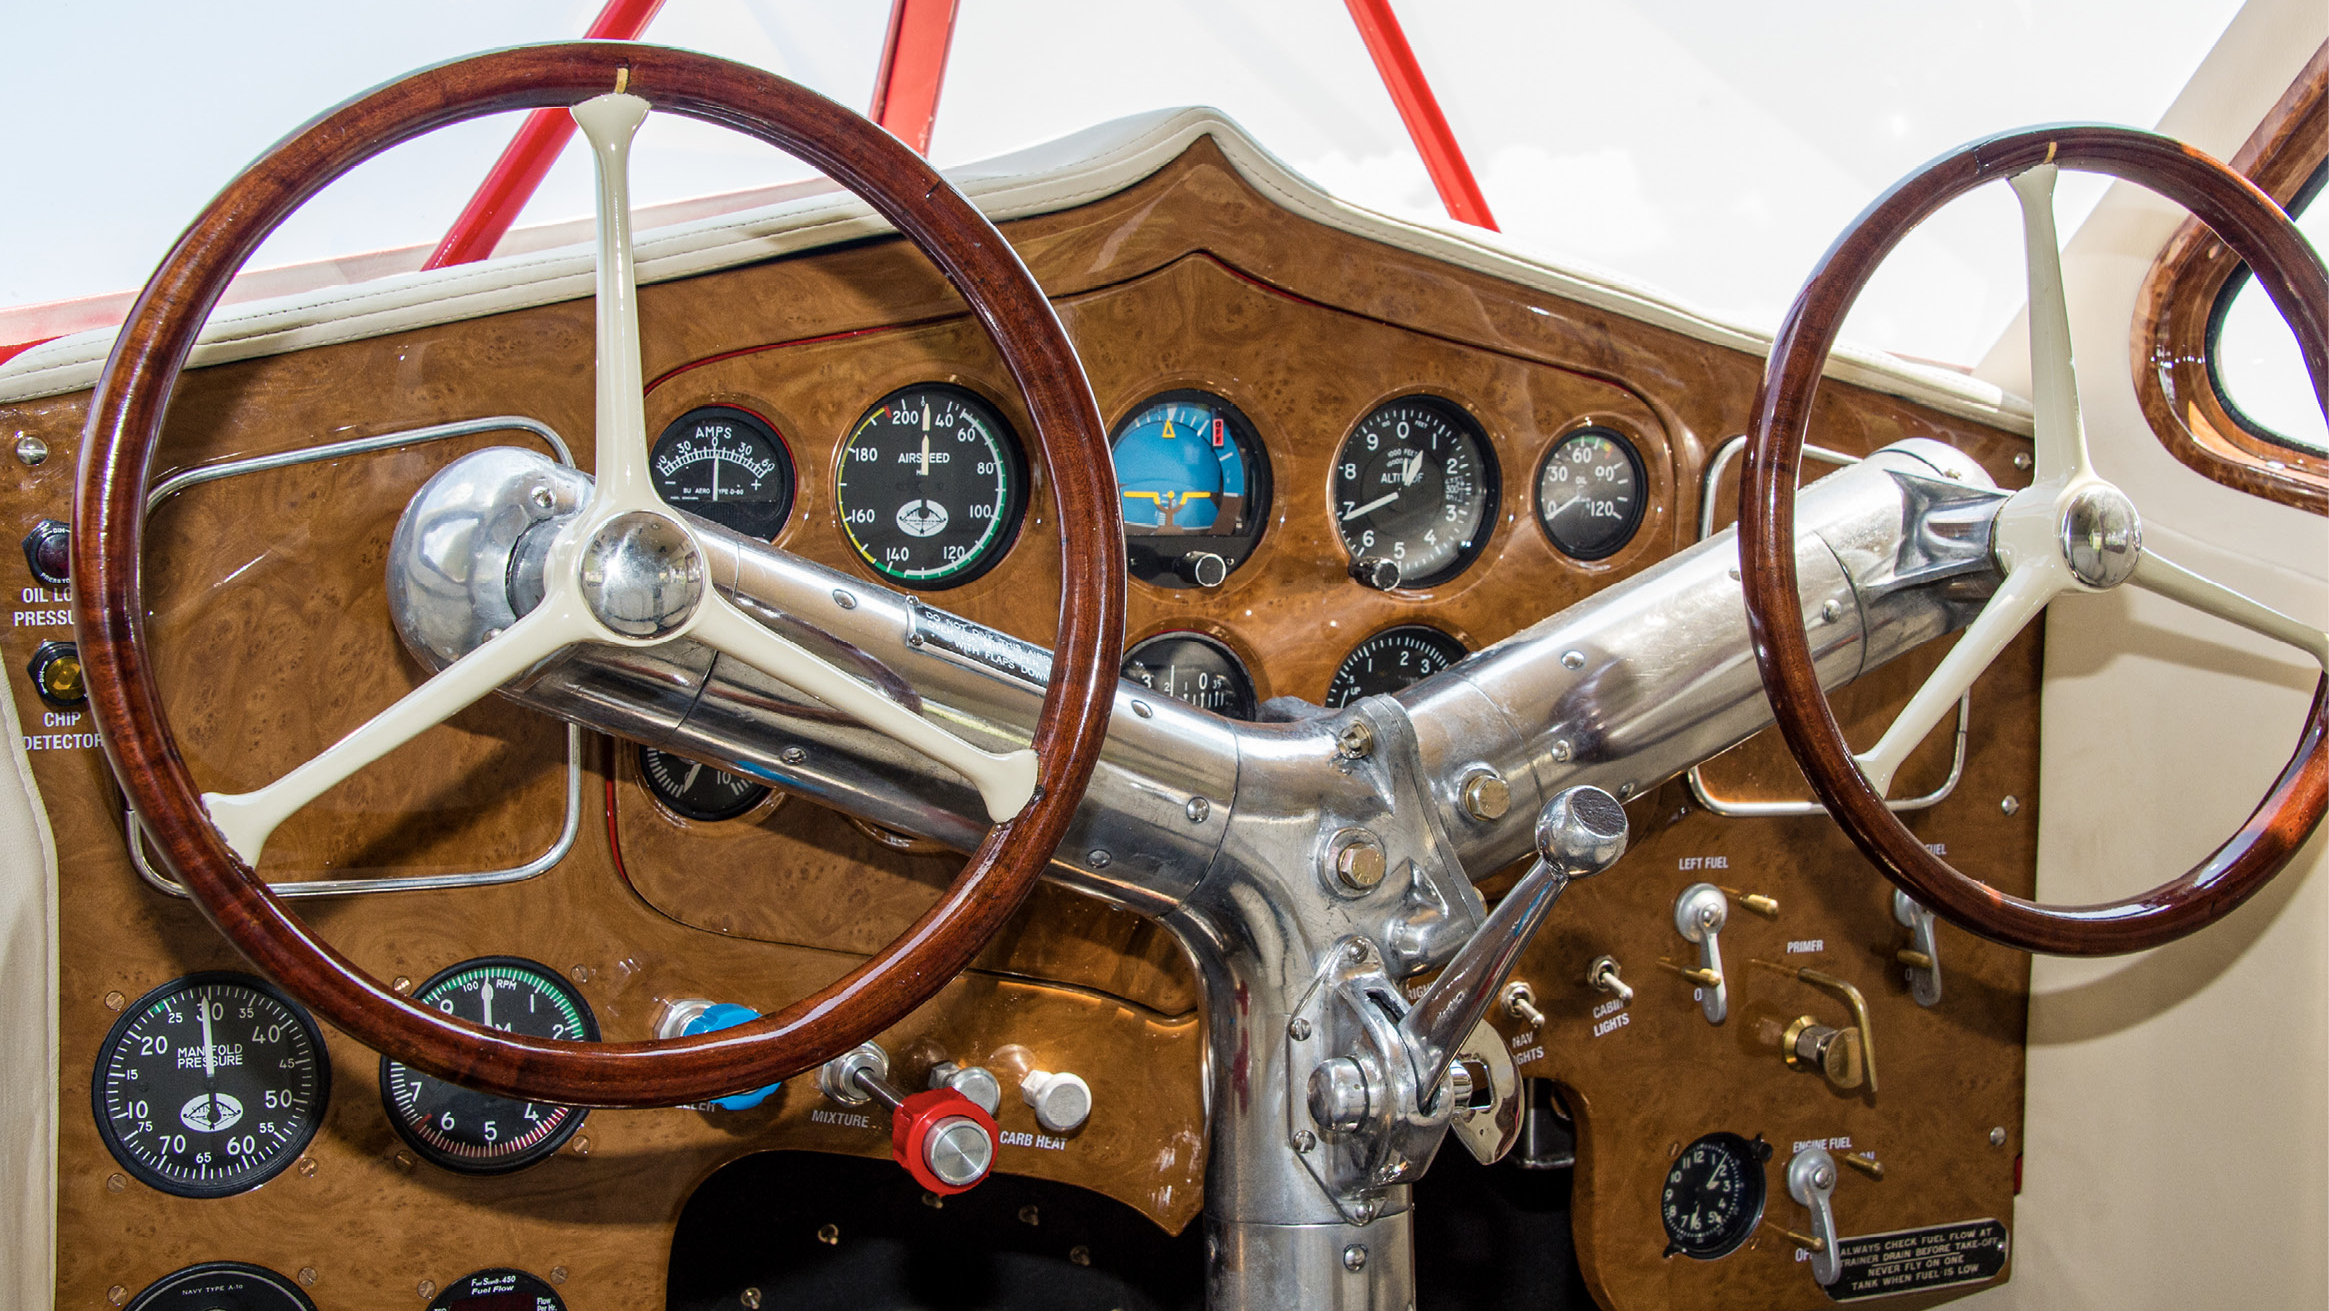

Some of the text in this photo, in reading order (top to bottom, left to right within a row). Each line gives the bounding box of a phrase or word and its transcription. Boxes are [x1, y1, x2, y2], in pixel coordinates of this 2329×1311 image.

[892, 410, 919, 425] 200
[935, 413, 953, 428] 40
[695, 426, 733, 439] AMPS
[957, 427, 976, 442] 60
[1396, 421, 1410, 439] 0
[677, 440, 692, 454] 30
[711, 437, 719, 446] 0
[738, 442, 752, 455] 30
[1366, 433, 1379, 451] 9
[855, 447, 877, 462] 180
[898, 452, 950, 464] AIRSEED
[1572, 447, 1592, 463] 60
[761, 458, 775, 472] 60
[977, 461, 995, 475] 80
[1344, 463, 1356, 480] 8
[1446, 458, 1458, 475] 2
[1549, 465, 1568, 482] 30
[969, 504, 992, 519] 100
[1343, 501, 1355, 514] 7
[1445, 504, 1457, 522] 3
[1590, 501, 1614, 517] 120
[852, 508, 875, 523] 160
[1362, 530, 1375, 547] 6
[1424, 528, 1437, 546] 4
[886, 546, 910, 561] 140
[943, 545, 965, 560] 120
[1394, 542, 1405, 559] 5
[22, 587, 73, 603] OIL LO
[13, 609, 75, 627] PRESSU
[926, 611, 941, 621] DO
[946, 618, 967, 631] NOT
[954, 640, 980, 656] WITH
[985, 651, 1016, 670] FLAPS
[1021, 664, 1049, 682] DOWN
[1399, 651, 1409, 666] 2
[1420, 658, 1430, 674] 3
[1199, 672, 1208, 690] 0
[1350, 686, 1361, 696] UP
[43, 711, 81, 728] CHIP
[22, 733, 102, 751] DETECTOR
[717, 770, 732, 786] 10
[1678, 856, 1729, 871] LEFT FUEL
[1786, 939, 1824, 954] PRIMER
[463, 979, 517, 993] 100 RPM
[168, 1013, 183, 1024] 25
[239, 1007, 254, 1019] 35
[552, 1024, 564, 1040] 2
[1593, 1012, 1630, 1037] LIGHTS
[252, 1024, 281, 1044] 40
[1512, 1031, 1533, 1048] NAV
[141, 1036, 168, 1056] 20
[177, 1043, 243, 1058] MANFOLD
[177, 1054, 243, 1069] PRESSURE
[279, 1057, 295, 1069] 45
[1514, 1046, 1545, 1066] GHTS
[126, 1069, 139, 1080] 15
[265, 1089, 293, 1109] 50
[410, 1082, 422, 1102] 7
[128, 1100, 148, 1119] 10
[524, 1102, 539, 1122] 4
[138, 1121, 153, 1132] 75
[441, 1112, 455, 1131] 6
[811, 1109, 870, 1129] MIXTURE
[259, 1122, 275, 1134] 55
[484, 1121, 498, 1141] 5
[159, 1135, 187, 1155] 70
[226, 1135, 256, 1155] 60
[1000, 1130, 1068, 1151] CARB HEAT
[1793, 1136, 1853, 1154] ENGINE FUEL
[195, 1152, 212, 1164] 65
[1682, 1157, 1691, 1169] 11
[1694, 1150, 1705, 1164] 12
[1670, 1170, 1682, 1184] 10
[1720, 1164, 1727, 1177] 2
[1722, 1180, 1731, 1192] 3
[1665, 1189, 1673, 1201] 9
[1669, 1205, 1677, 1217] 8
[1718, 1198, 1726, 1209] 4
[1681, 1215, 1689, 1228] 7
[1708, 1211, 1717, 1224] 5
[1840, 1227, 1993, 1257] ALWAYS CHECK FUEL FLOW AT
[1795, 1247, 1813, 1262] OF
[1839, 1237, 1999, 1268] TRAINER DRAIN BEFORE TAKE-OFF
[1867, 1254, 1965, 1277] NEVER FLY ON ONE
[1851, 1263, 1980, 1291] TANK WHEN FUEL IS LOW
[182, 1288, 203, 1296] NAVY
[206, 1285, 225, 1293] TYPE
[471, 1284, 515, 1296] Fuel Flow
[536, 1297, 552, 1305] Flow
